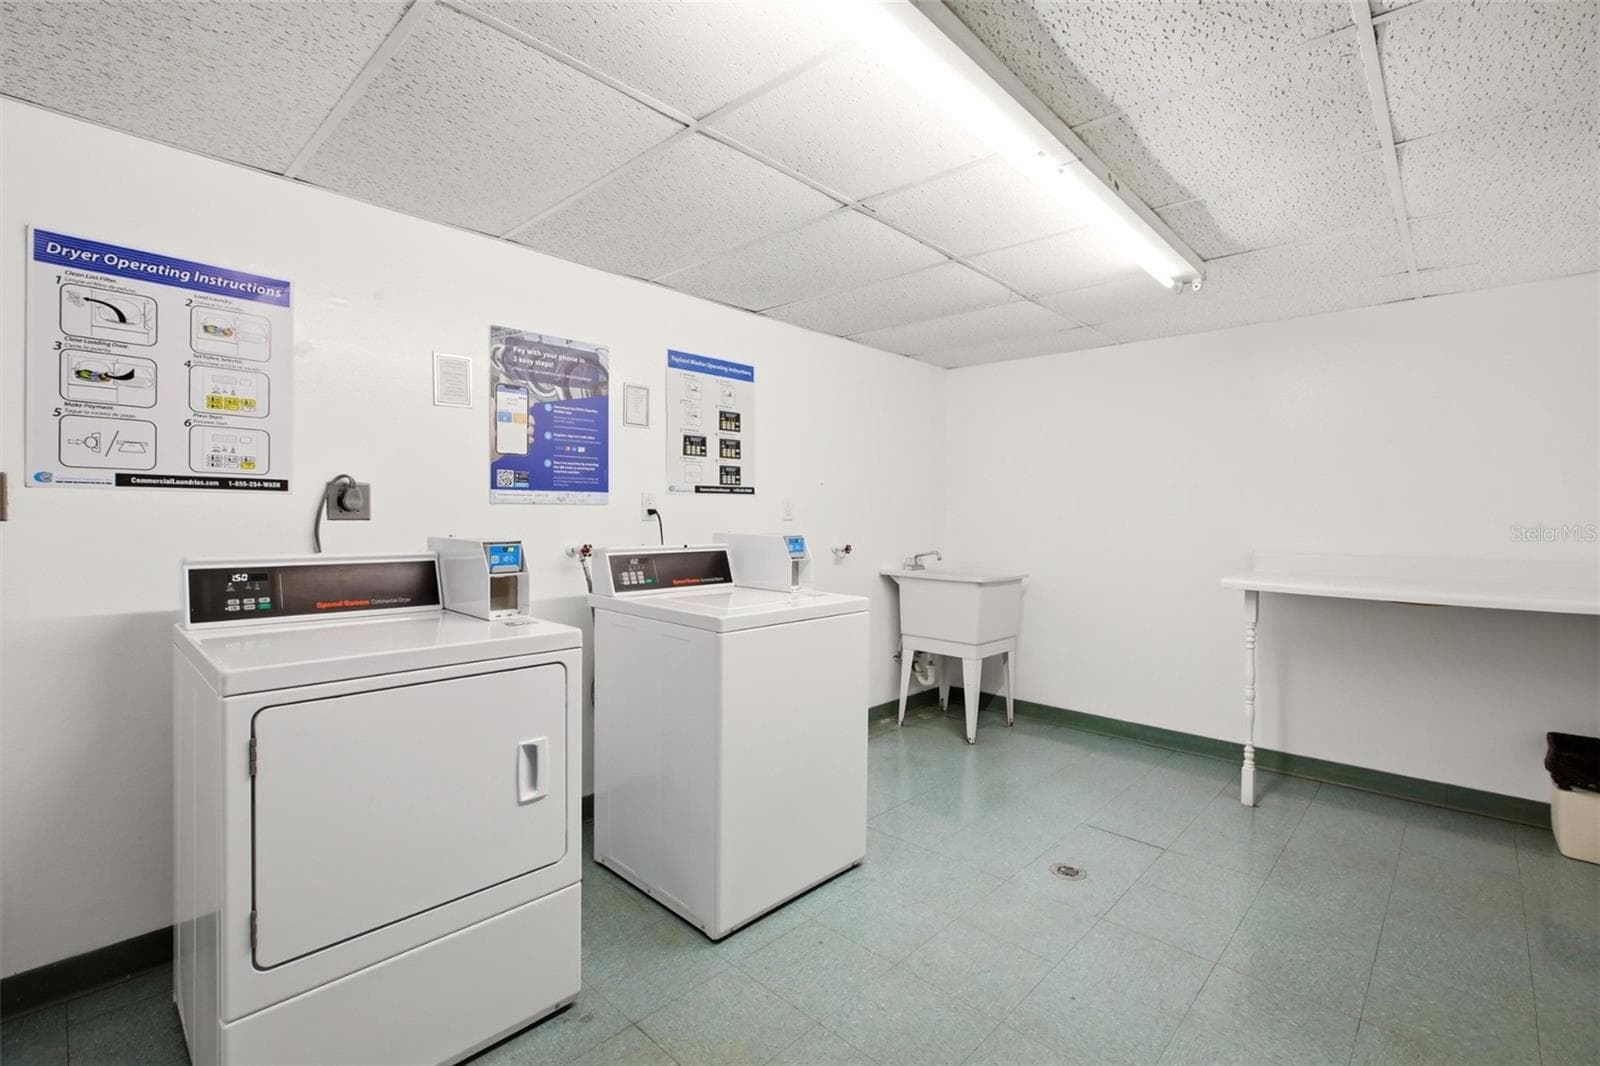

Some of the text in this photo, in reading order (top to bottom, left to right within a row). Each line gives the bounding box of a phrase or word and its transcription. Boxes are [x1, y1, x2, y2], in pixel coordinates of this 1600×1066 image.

[46, 242, 282, 298] Dryer Operating Instructions
[56, 276, 61, 284] 1
[185, 298, 193, 307] 2
[53, 341, 62, 350] 3
[84, 338, 111, 347] Loading
[513, 346, 525, 355] Pay
[542, 351, 558, 360] your
[558, 353, 578, 363] phone
[184, 360, 191, 368] 4
[518, 358, 533, 367] easy
[690, 359, 706, 367] Washer
[706, 362, 728, 373] Operating
[53, 408, 62, 417] 5
[184, 419, 192, 427] 6
[131, 477, 219, 487] CommercialLaundries.com
[316, 601, 342, 609] Speed
[343, 600, 369, 608] Queen
